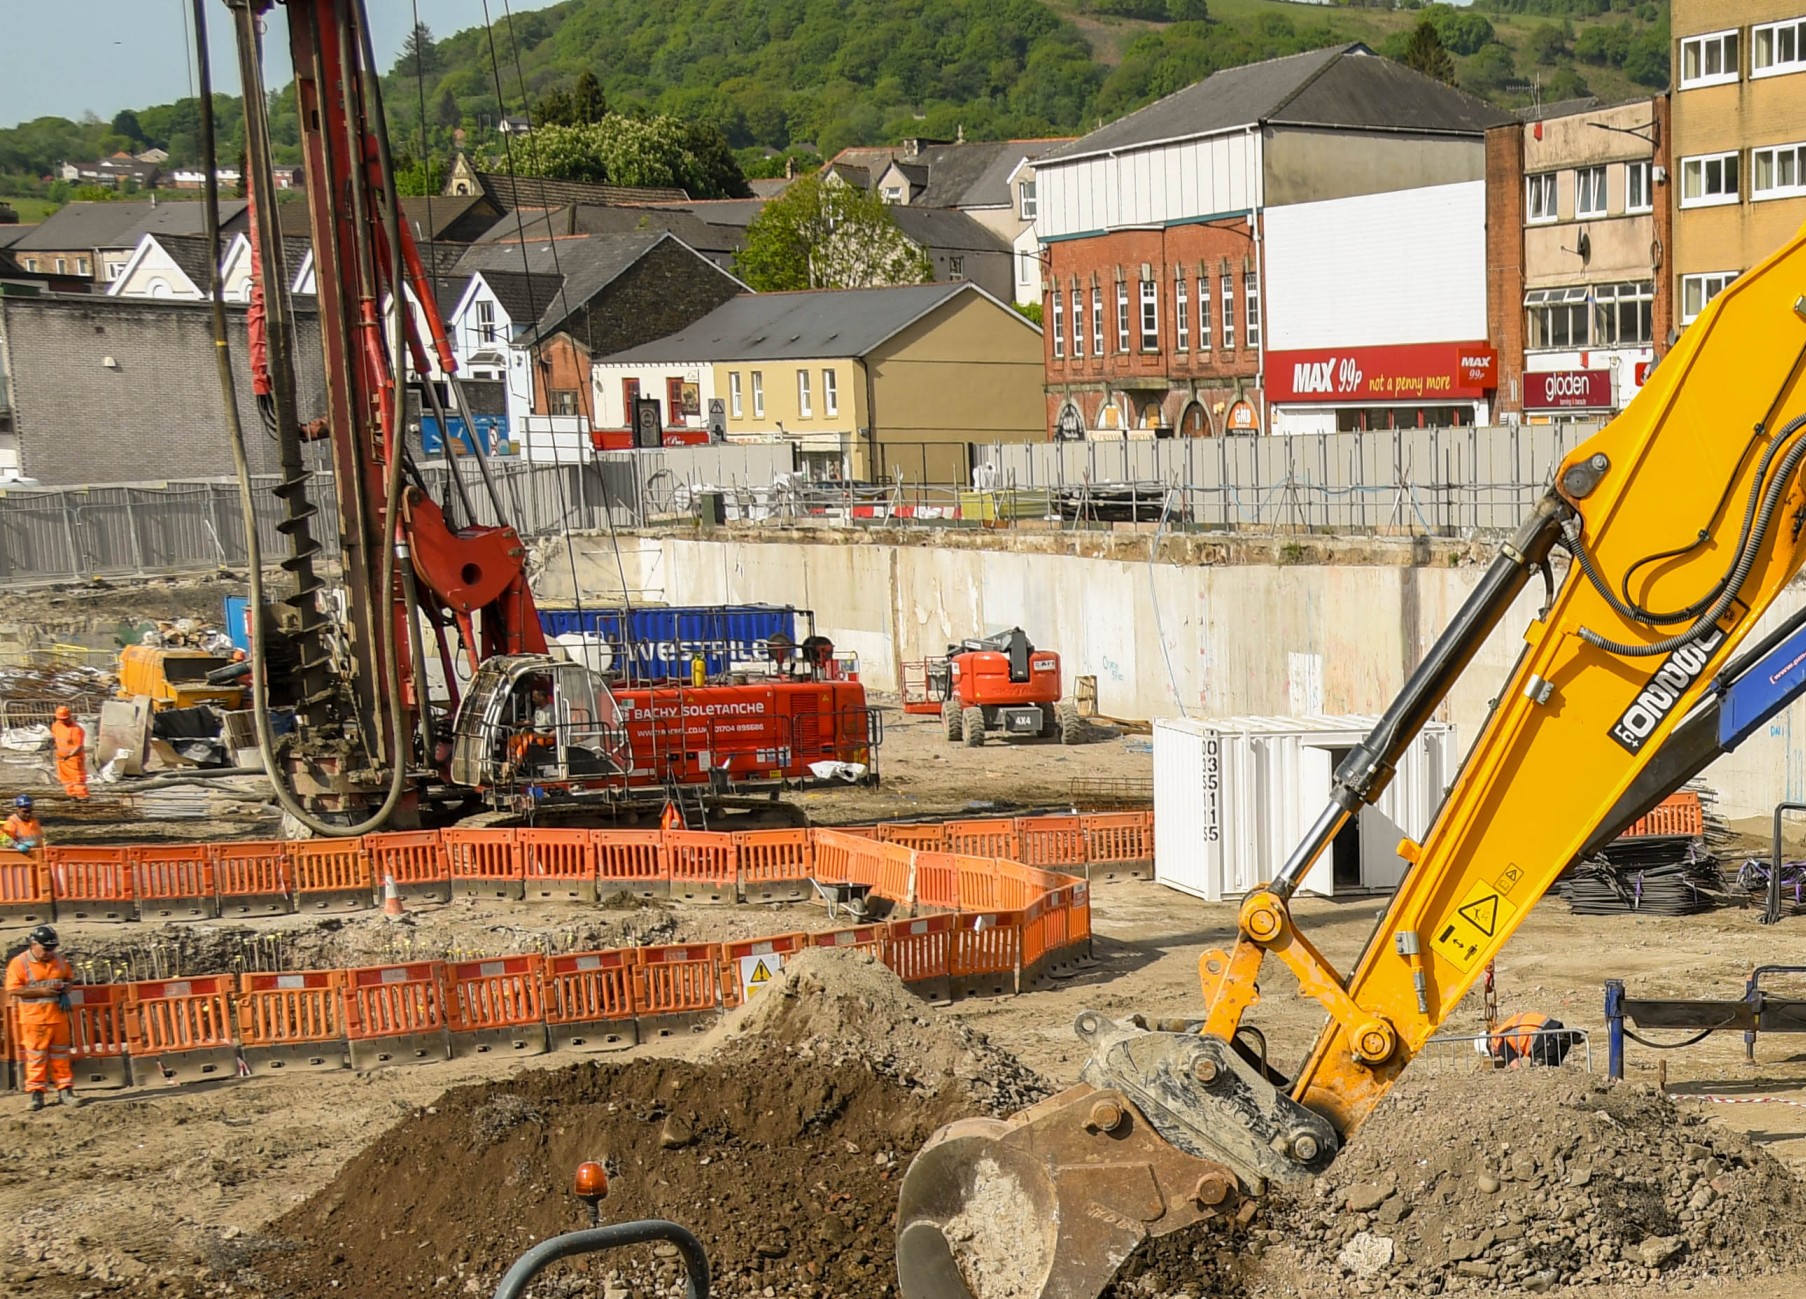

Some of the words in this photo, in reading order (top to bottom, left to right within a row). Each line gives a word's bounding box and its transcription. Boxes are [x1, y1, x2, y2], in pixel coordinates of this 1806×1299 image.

[1461, 356, 1492, 367] MAX
[1293, 358, 1336, 392] MAX
[1369, 375, 1385, 392] not
[1387, 380, 1393, 391] a
[1395, 378, 1423, 397] penny
[1426, 375, 1450, 391] more
[634, 706, 677, 719] BACHY
[1207, 740, 1218, 841] 035115
